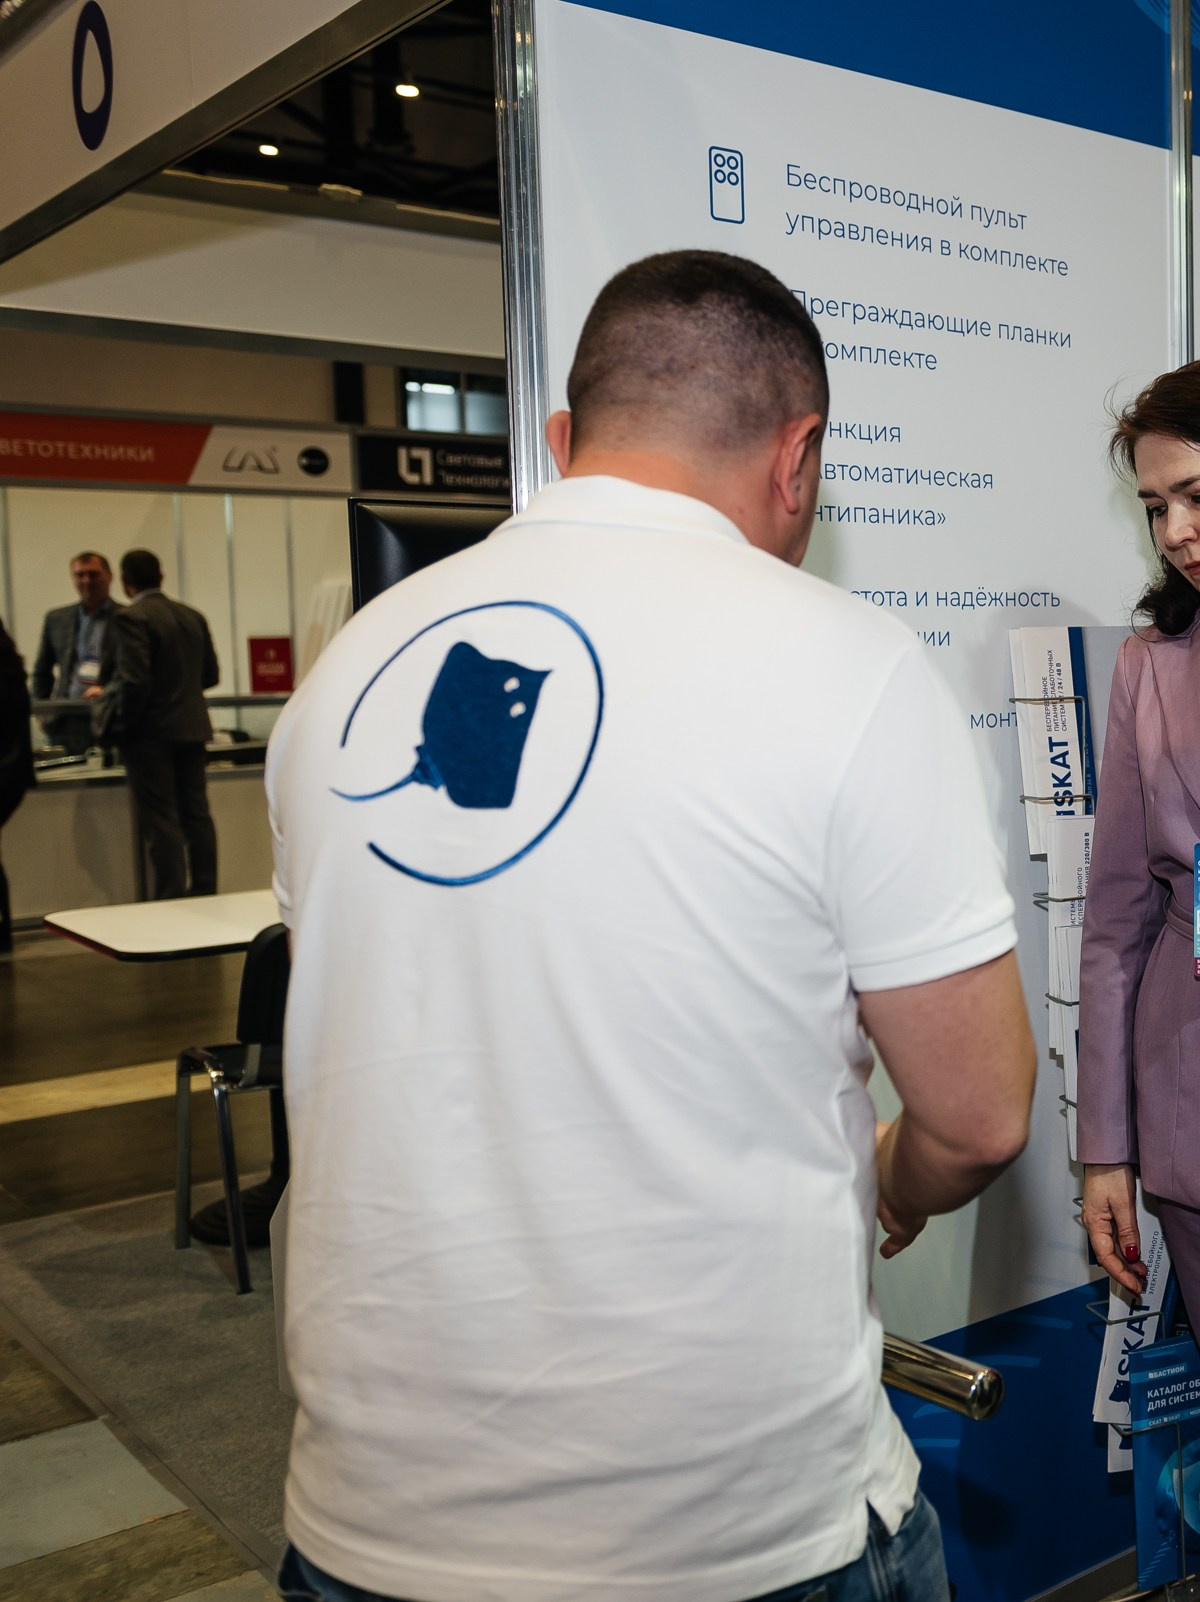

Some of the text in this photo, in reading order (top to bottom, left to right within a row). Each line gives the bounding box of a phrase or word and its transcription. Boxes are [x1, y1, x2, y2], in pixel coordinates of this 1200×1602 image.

[785, 163, 1028, 231] Беспроводной пульт
[785, 209, 1070, 278] управления в комплекте
[997, 319, 1072, 350] планки
[822, 341, 938, 374] омплекте
[828, 421, 901, 445] нкция
[436, 448, 505, 469] Световые
[818, 463, 994, 489] втоматическая
[815, 505, 947, 527] нтипаника»
[915, 591, 929, 607] и
[936, 586, 1061, 611] надёжность
[970, 712, 1018, 729] монт
[1058, 704, 1068, 732] СИСТЕМ
[1047, 736, 1075, 808] SKAT
[1117, 1298, 1151, 1376] SKAT
[1147, 1381, 1187, 1399] КАТАЛОГ
[1147, 1398, 1167, 1413] ДЛЯ
